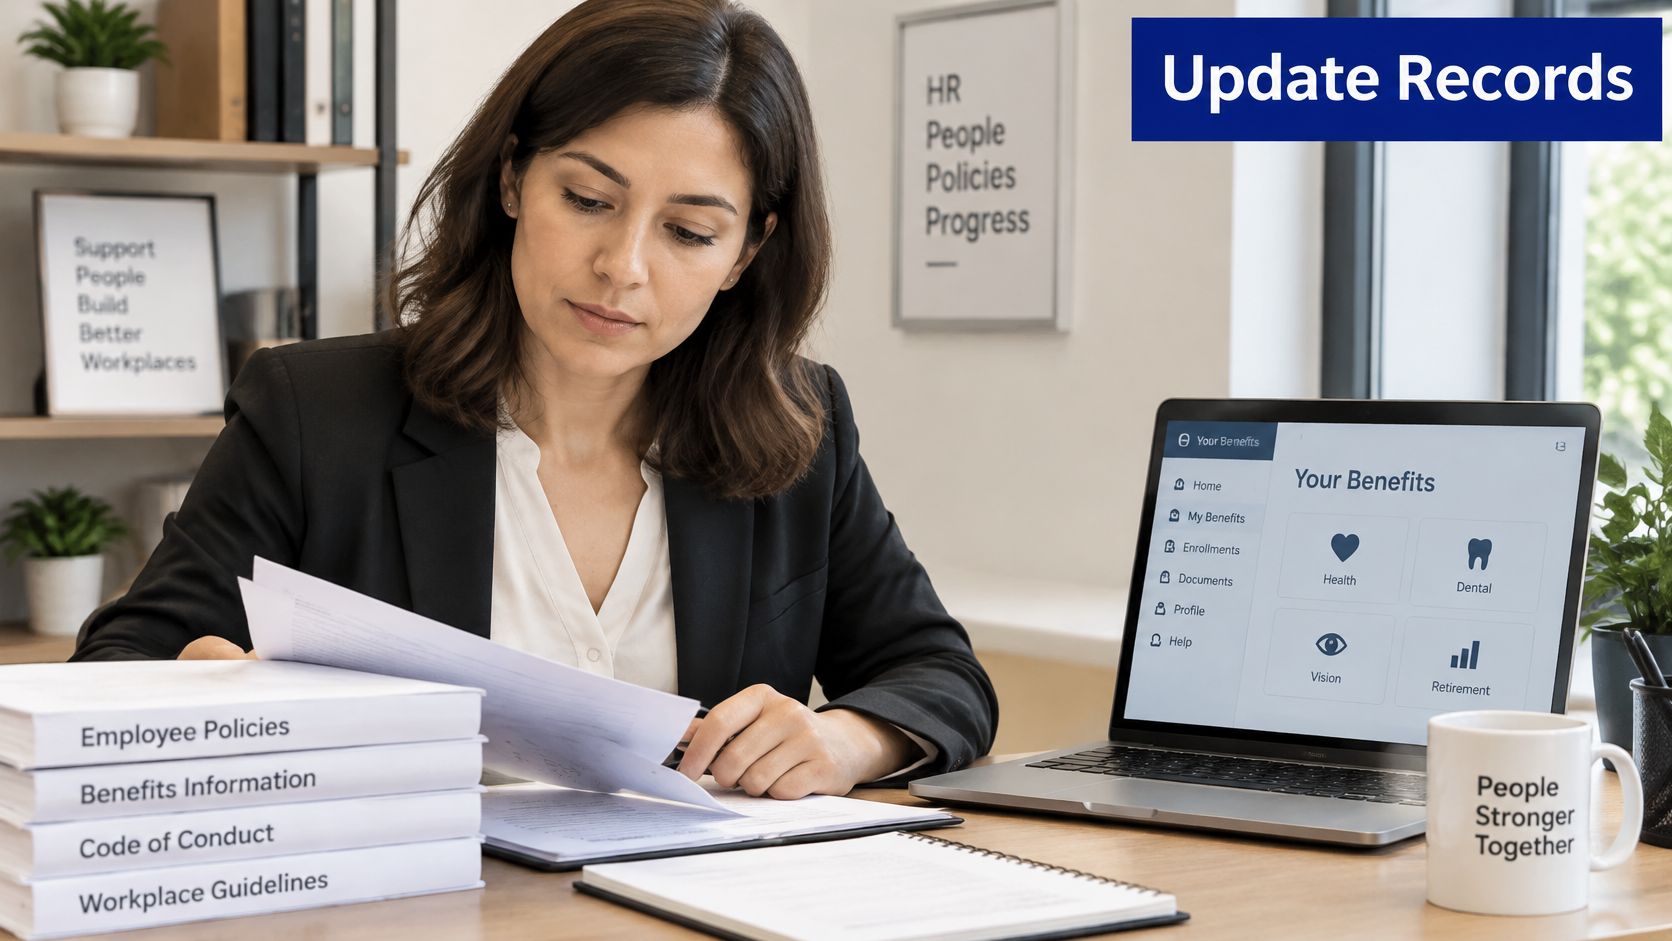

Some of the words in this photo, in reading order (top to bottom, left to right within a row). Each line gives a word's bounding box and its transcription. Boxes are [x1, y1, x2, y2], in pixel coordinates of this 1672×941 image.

[927, 73, 962, 105] HR
[927, 117, 1005, 153] People
[927, 161, 1016, 192] Policies
[926, 207, 1029, 243] Progress
[73, 235, 156, 262] Support
[75, 265, 146, 289] People
[77, 293, 130, 315] Build
[79, 321, 143, 344] Better
[81, 352, 197, 375] Workplaces
[1198, 436, 1218, 445] Your
[1194, 481, 1221, 491] Home
[1296, 469, 1342, 488] Your
[1347, 470, 1435, 492] Benefits
[1188, 512, 1203, 523] My
[1205, 512, 1245, 523] Benefits
[1183, 542, 1239, 555] Enrollments
[1179, 573, 1233, 586] Documents
[1324, 574, 1356, 585] Health
[1457, 582, 1492, 593] Dental
[1174, 604, 1205, 616] Profile
[1170, 636, 1192, 648] Help
[1311, 672, 1341, 683] Vision
[1432, 681, 1490, 695] Retirement
[82, 724, 196, 750] Employee
[205, 717, 289, 739] Policies
[81, 780, 176, 804] Benefits
[185, 770, 315, 796] Information
[1478, 776, 1558, 803] People
[1476, 804, 1575, 831] Stronger
[80, 836, 141, 858] Code
[148, 832, 171, 853] of
[178, 825, 274, 849] Conduct
[1475, 833, 1575, 862] Together
[79, 886, 204, 914] Workplace
[211, 873, 328, 899] Guidelines
